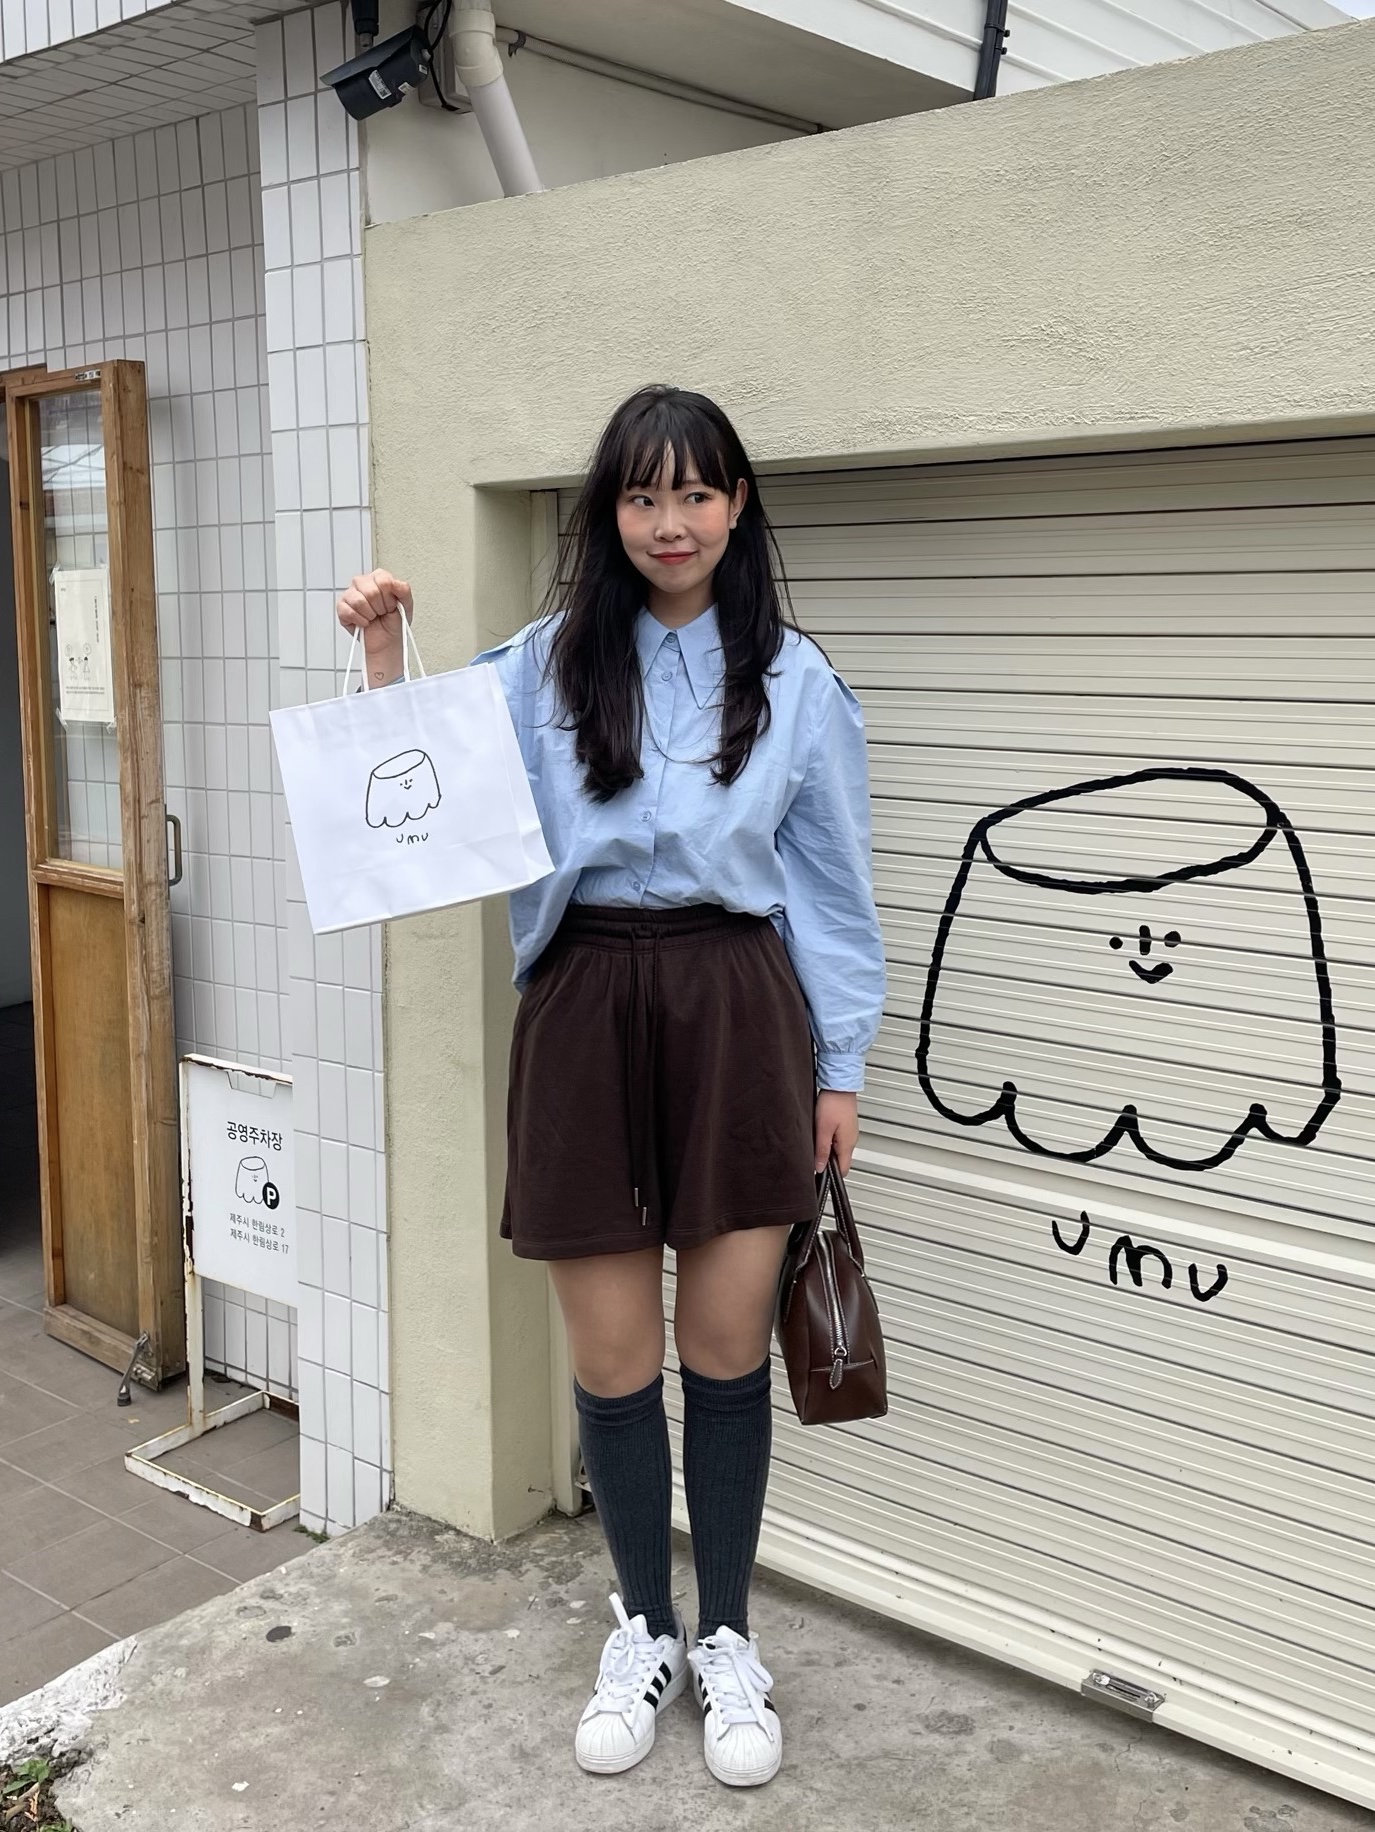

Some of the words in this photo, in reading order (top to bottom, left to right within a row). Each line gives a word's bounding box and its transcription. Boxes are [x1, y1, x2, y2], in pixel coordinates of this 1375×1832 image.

[396, 832, 429, 845] umu
[226, 1120, 283, 1152] 공영주차장
[265, 1185, 277, 1206] P
[229, 1212, 249, 1228] 제주시
[252, 1218, 279, 1236] 한림상로
[280, 1227, 285, 1238] 2
[230, 1227, 250, 1244] 제주시
[252, 1234, 280, 1252] 한림상로
[281, 1243, 289, 1254] 17
[1051, 1210, 1229, 1302] umu
